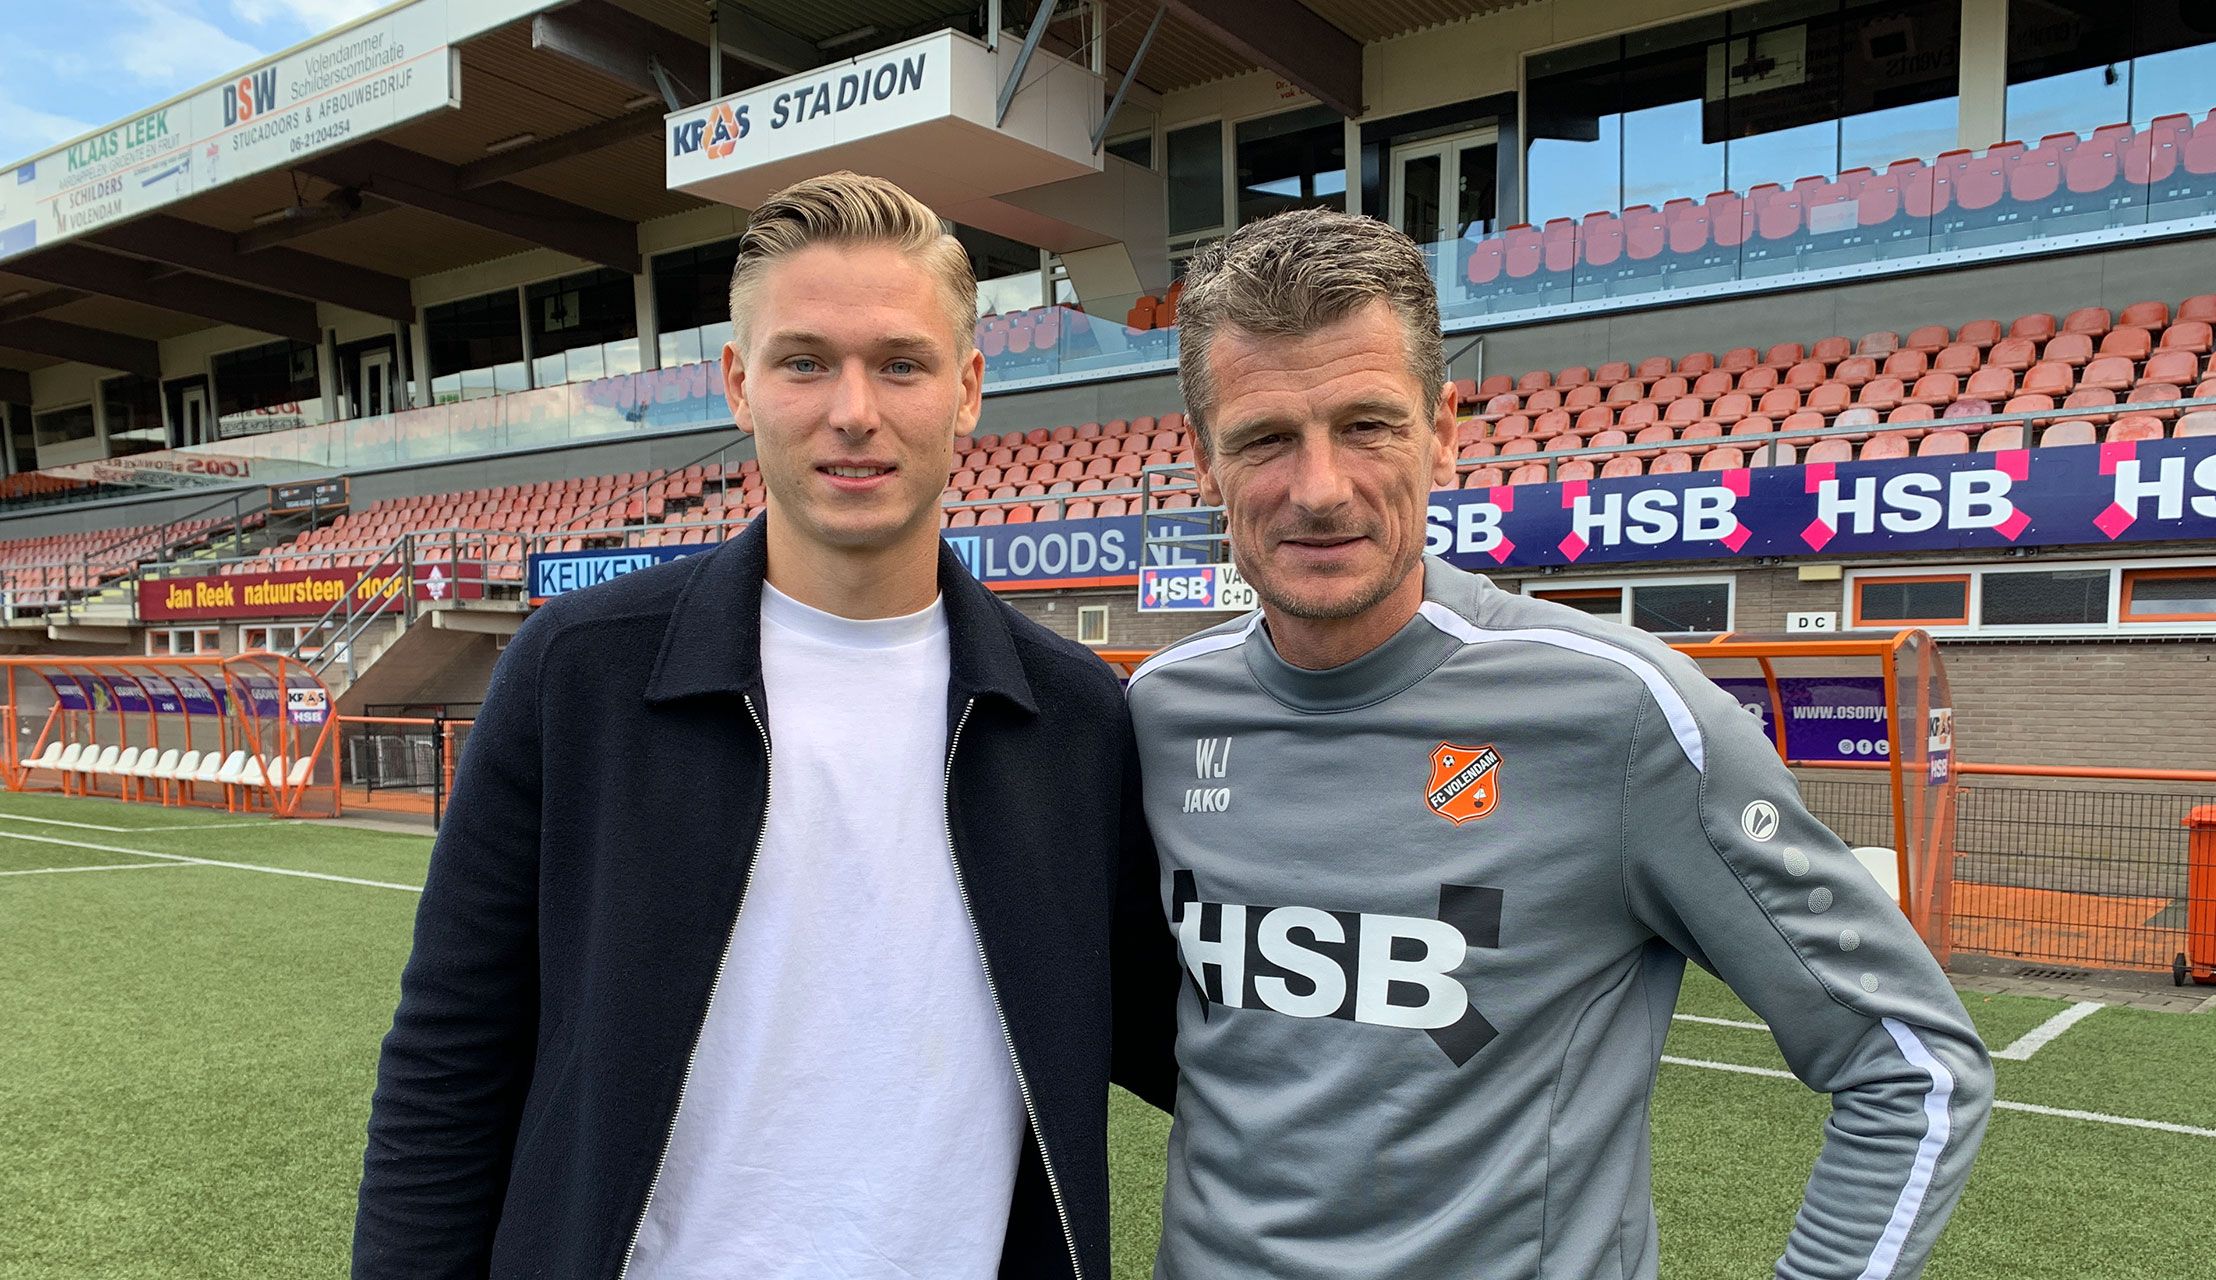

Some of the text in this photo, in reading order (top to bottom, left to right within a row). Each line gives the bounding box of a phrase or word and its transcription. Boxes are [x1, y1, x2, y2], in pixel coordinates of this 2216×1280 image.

[291, 43, 404, 101] Schilderscombinatie
[305, 32, 384, 76] Volendammer
[222, 67, 277, 127] DSW
[233, 68, 413, 151] STUCADOORS & AFBOUWBEDRIJF
[673, 53, 926, 158] KRAS STADION
[68, 130, 118, 172] KLAAS
[126, 110, 169, 149] LEEK
[290, 119, 351, 153] 06-21204254
[69, 176, 123, 209] SCHILDERS
[70, 199, 122, 229] VOLENDAM
[1573, 486, 1737, 546] HSB
[1818, 469, 2014, 535] HSB
[1422, 503, 1503, 556] SB
[166, 583, 192, 609] Jan
[196, 581, 235, 608] Reek
[244, 576, 344, 606] natuursteen
[1150, 576, 1208, 600] HSB
[1222, 589, 1253, 605] C+D
[1223, 568, 1246, 584] VA
[293, 711, 322, 722] HSB
[1196, 737, 1232, 779] WJ
[1430, 750, 1498, 809] FC VOLENDAM
[1931, 758, 1948, 778] HSB
[1182, 788, 1230, 814] JAKO
[1178, 902, 1468, 1030] HSB
